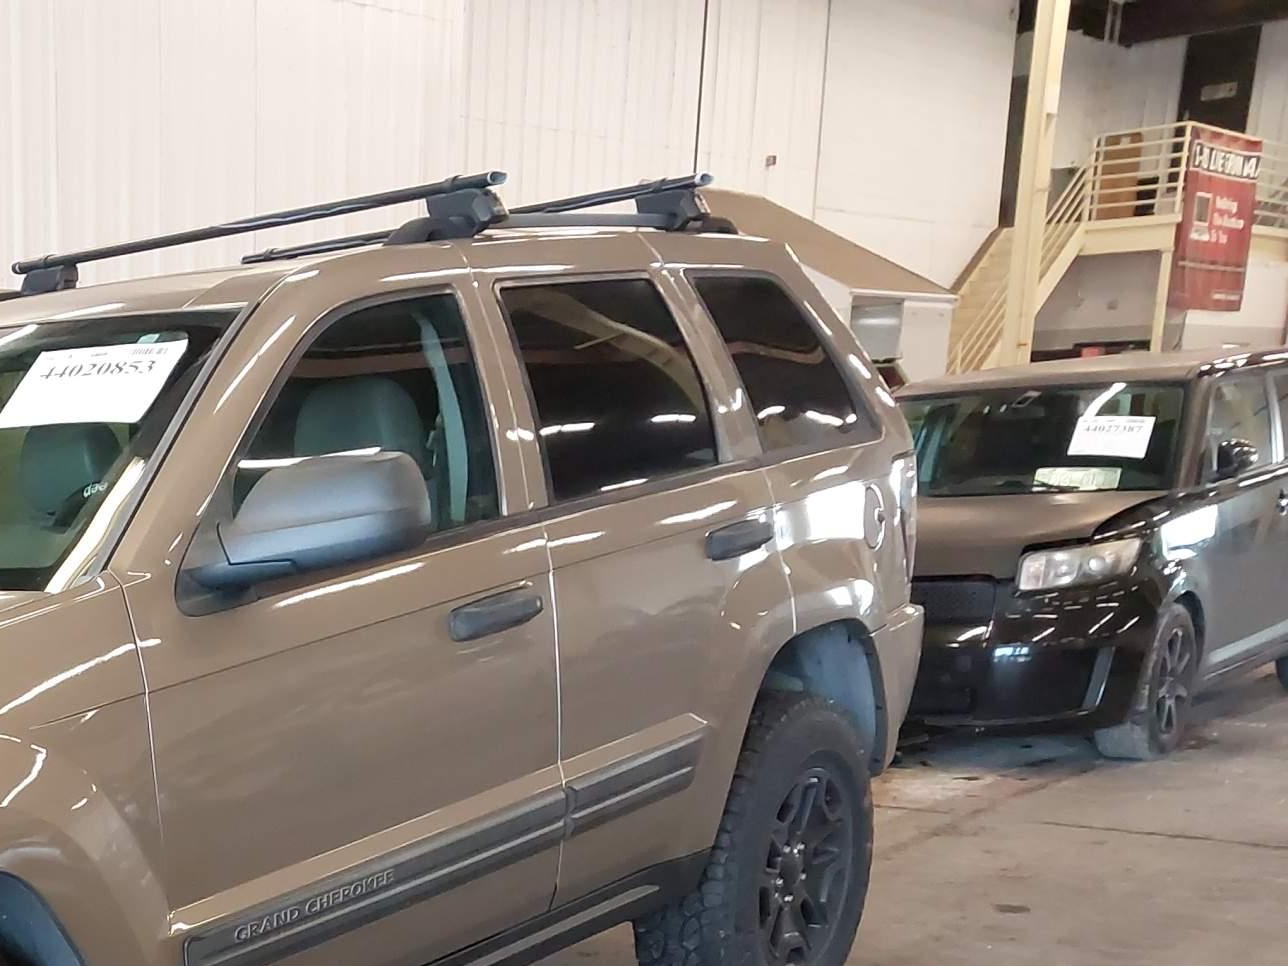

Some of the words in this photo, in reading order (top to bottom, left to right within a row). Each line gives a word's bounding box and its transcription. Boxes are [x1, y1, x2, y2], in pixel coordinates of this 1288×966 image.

[39, 360, 157, 380] 44020853
[234, 906, 300, 943] GRAND
[305, 869, 396, 916] CHEROKEE
